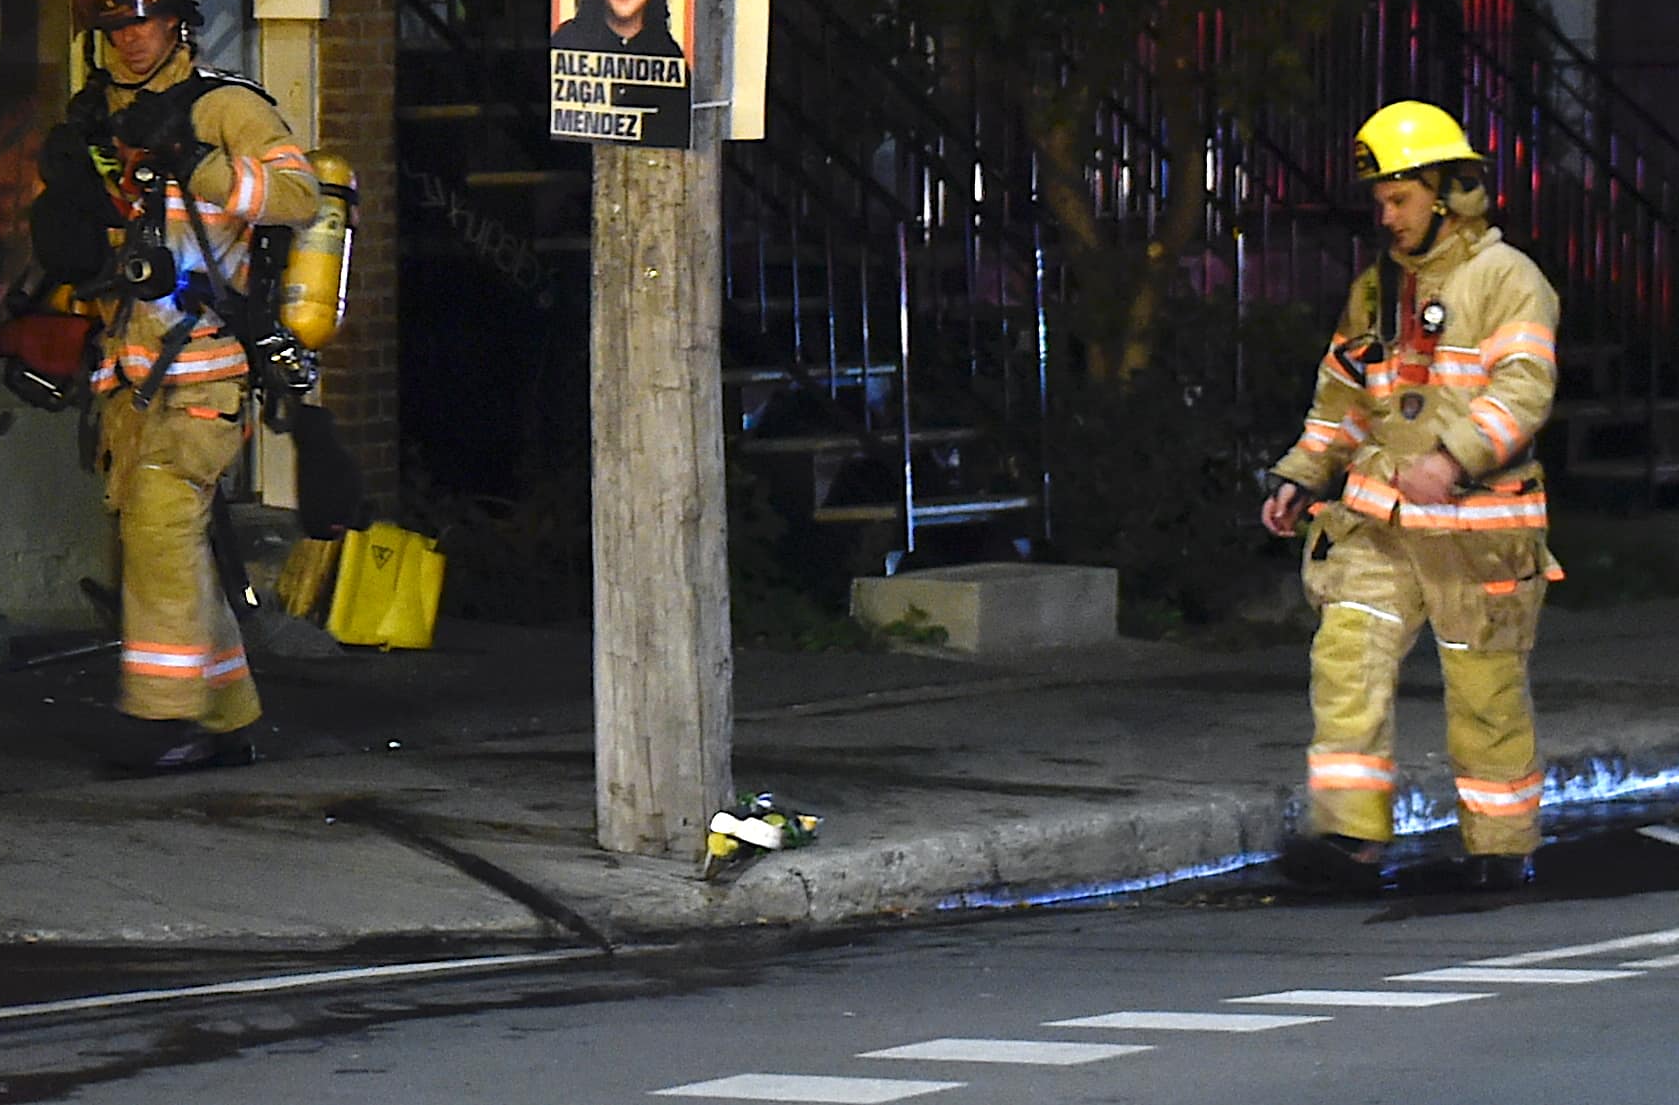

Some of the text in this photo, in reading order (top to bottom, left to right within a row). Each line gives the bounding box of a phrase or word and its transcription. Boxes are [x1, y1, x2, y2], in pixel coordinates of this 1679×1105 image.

[554, 52, 682, 84] ALEJANDRA
[554, 78, 607, 105] ZAGA
[554, 108, 638, 137] MENDEZ
